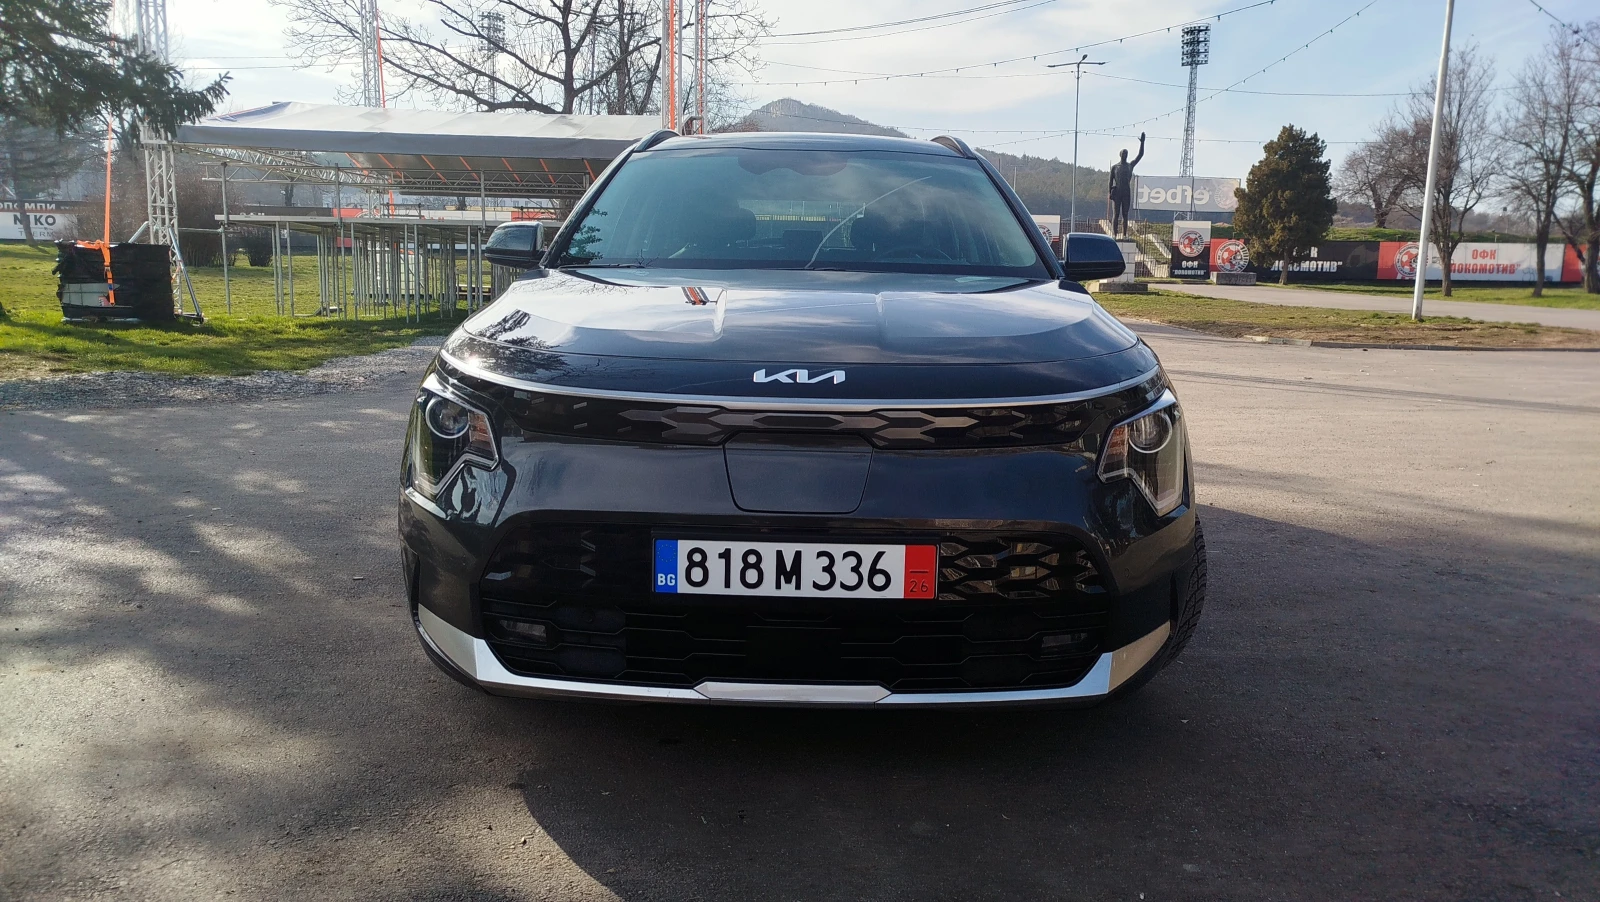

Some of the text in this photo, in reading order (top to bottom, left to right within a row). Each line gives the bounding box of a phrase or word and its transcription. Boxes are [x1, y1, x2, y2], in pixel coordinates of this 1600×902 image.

[1472, 249, 1497, 260] ОФК
[657, 573, 676, 586] BG
[909, 579, 929, 593] 26
